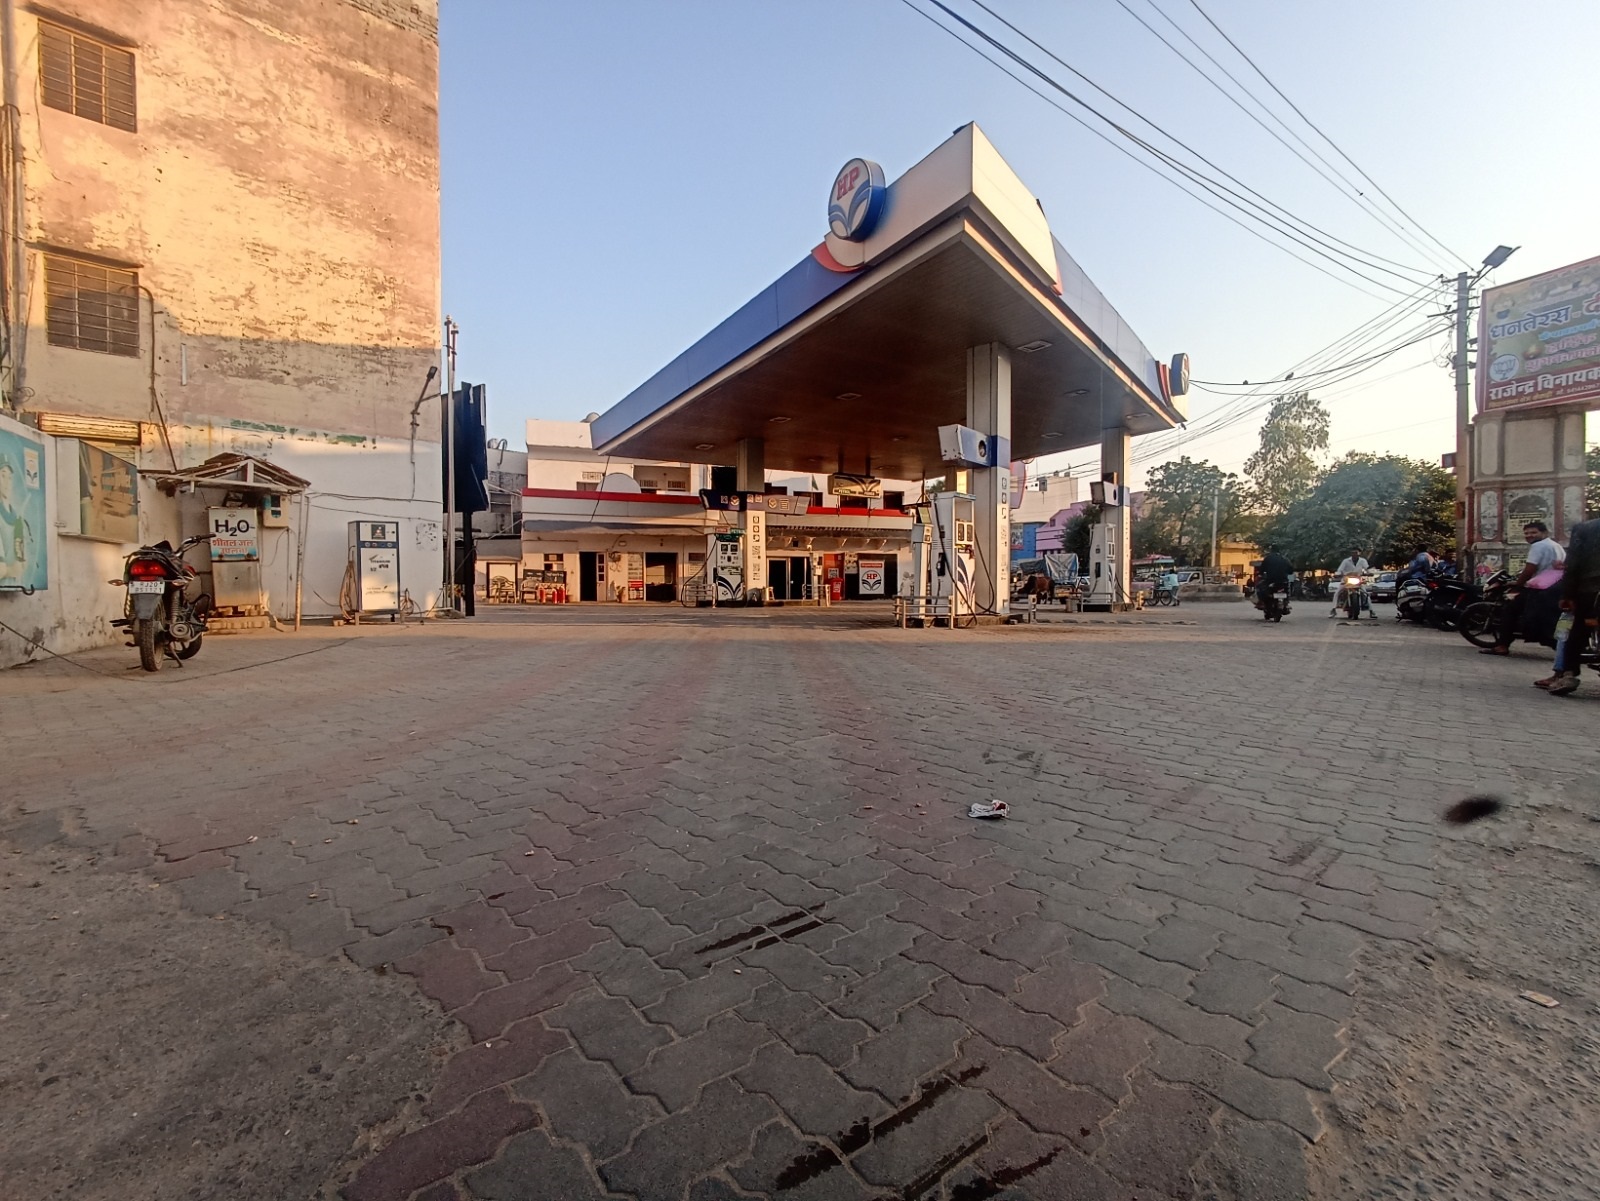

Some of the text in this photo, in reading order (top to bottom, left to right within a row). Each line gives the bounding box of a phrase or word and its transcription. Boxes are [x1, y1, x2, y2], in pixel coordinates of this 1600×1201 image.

[837, 166, 860, 201] HP
[1490, 305, 1571, 338] धनतेरस
[1489, 381, 1535, 399] राजेन्द्र
